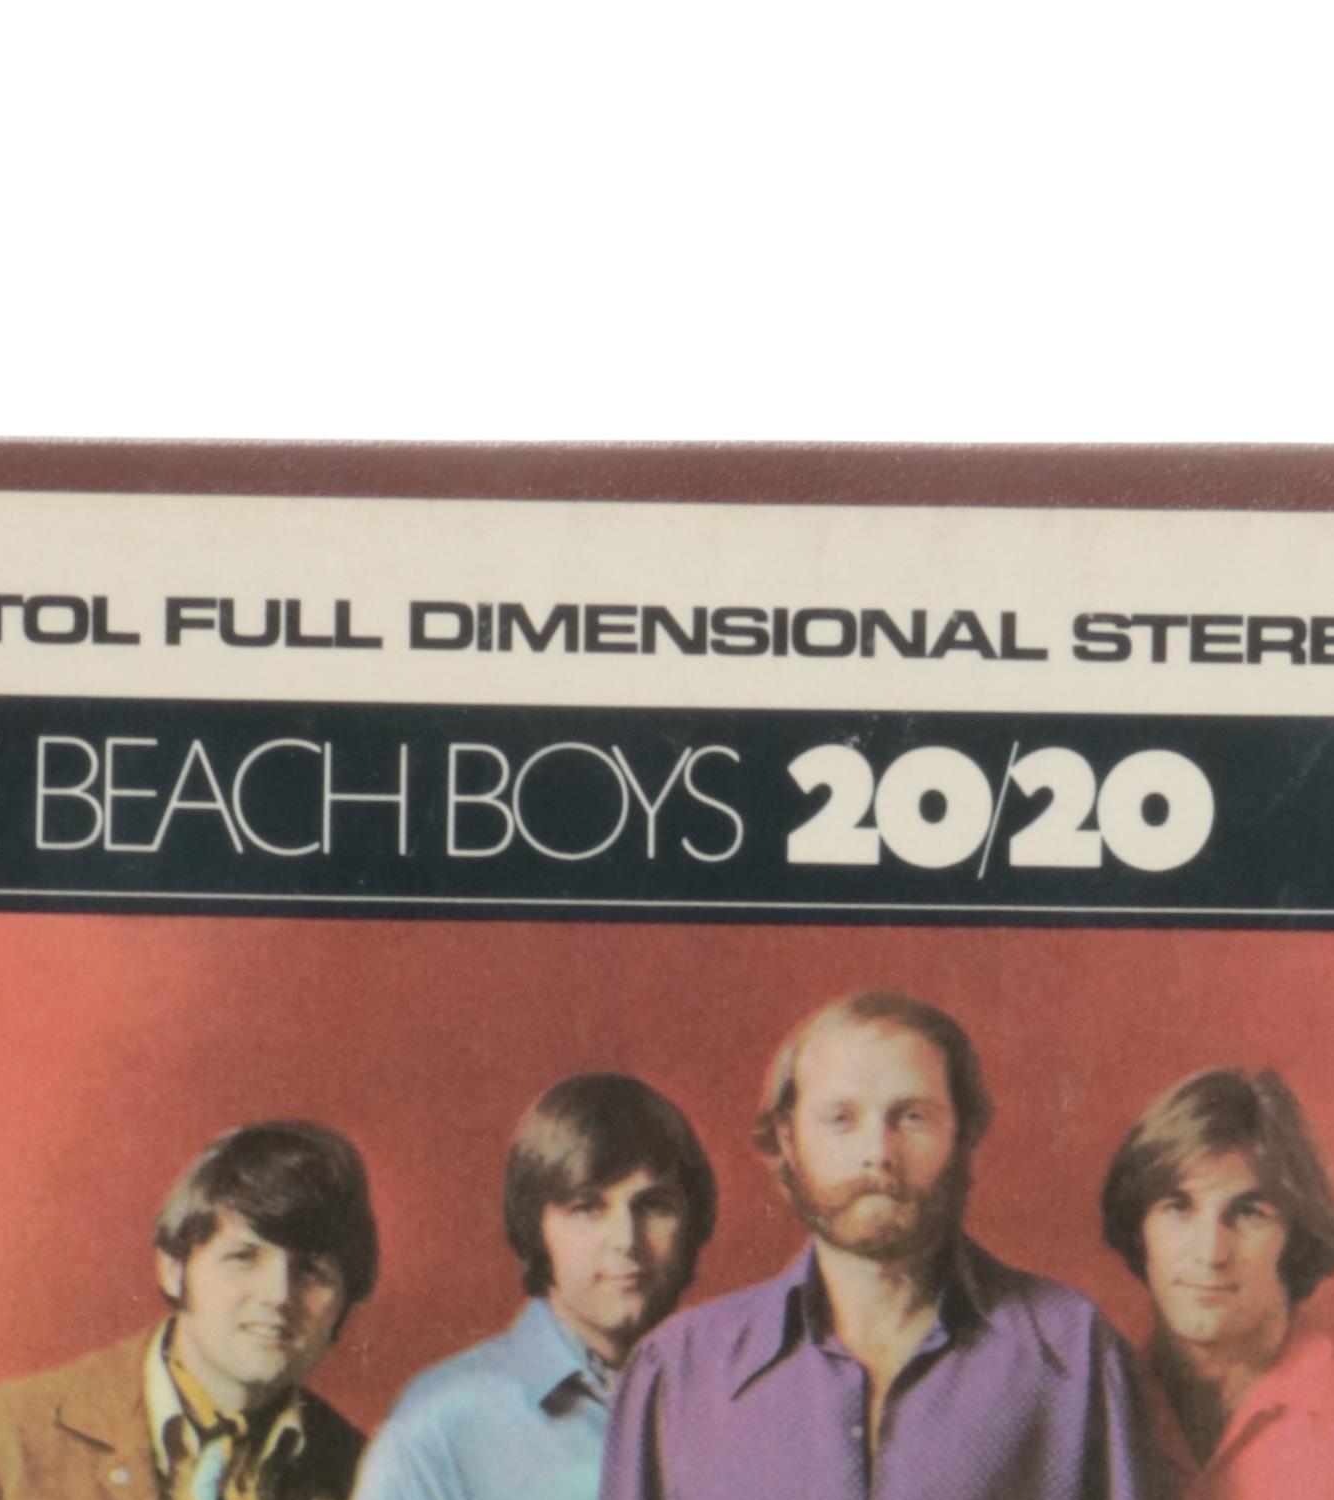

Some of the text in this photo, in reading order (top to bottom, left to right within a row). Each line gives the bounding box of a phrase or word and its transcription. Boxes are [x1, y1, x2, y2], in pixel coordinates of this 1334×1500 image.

[166, 596, 383, 651] FULL
[409, 601, 1048, 661] DIMENSIONAL
[36, 735, 408, 856] BEACH
[446, 742, 745, 862] BOYS
[785, 740, 1215, 880] 20/20
